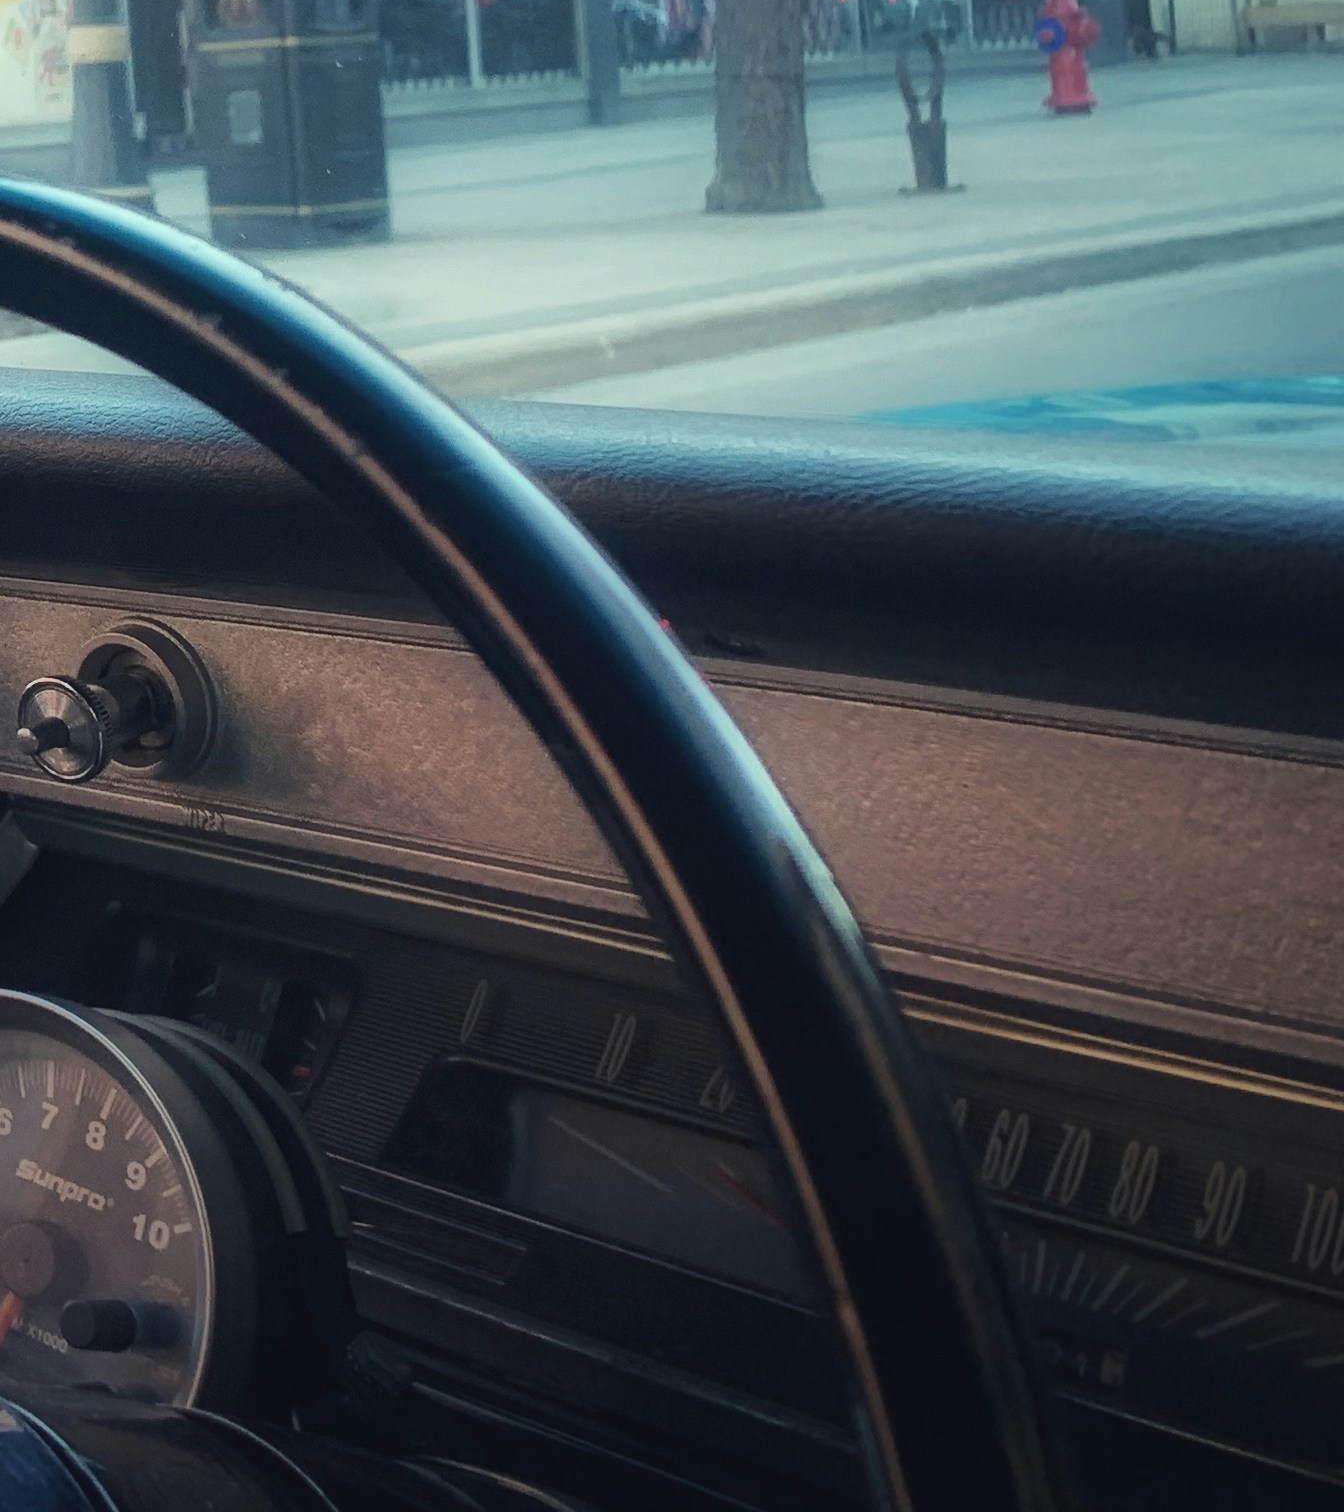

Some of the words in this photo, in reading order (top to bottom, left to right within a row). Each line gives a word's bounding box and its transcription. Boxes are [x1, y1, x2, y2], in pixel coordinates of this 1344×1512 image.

[40, 1102, 59, 1131] 7
[85, 1121, 107, 1151] 8
[126, 1160, 147, 1191] 9
[980, 1108, 1030, 1189] 60
[1043, 1122, 1092, 1208] 70
[1108, 1139, 1160, 1225] 80
[1193, 1160, 1247, 1247] 90
[132, 1214, 170, 1251] 10
